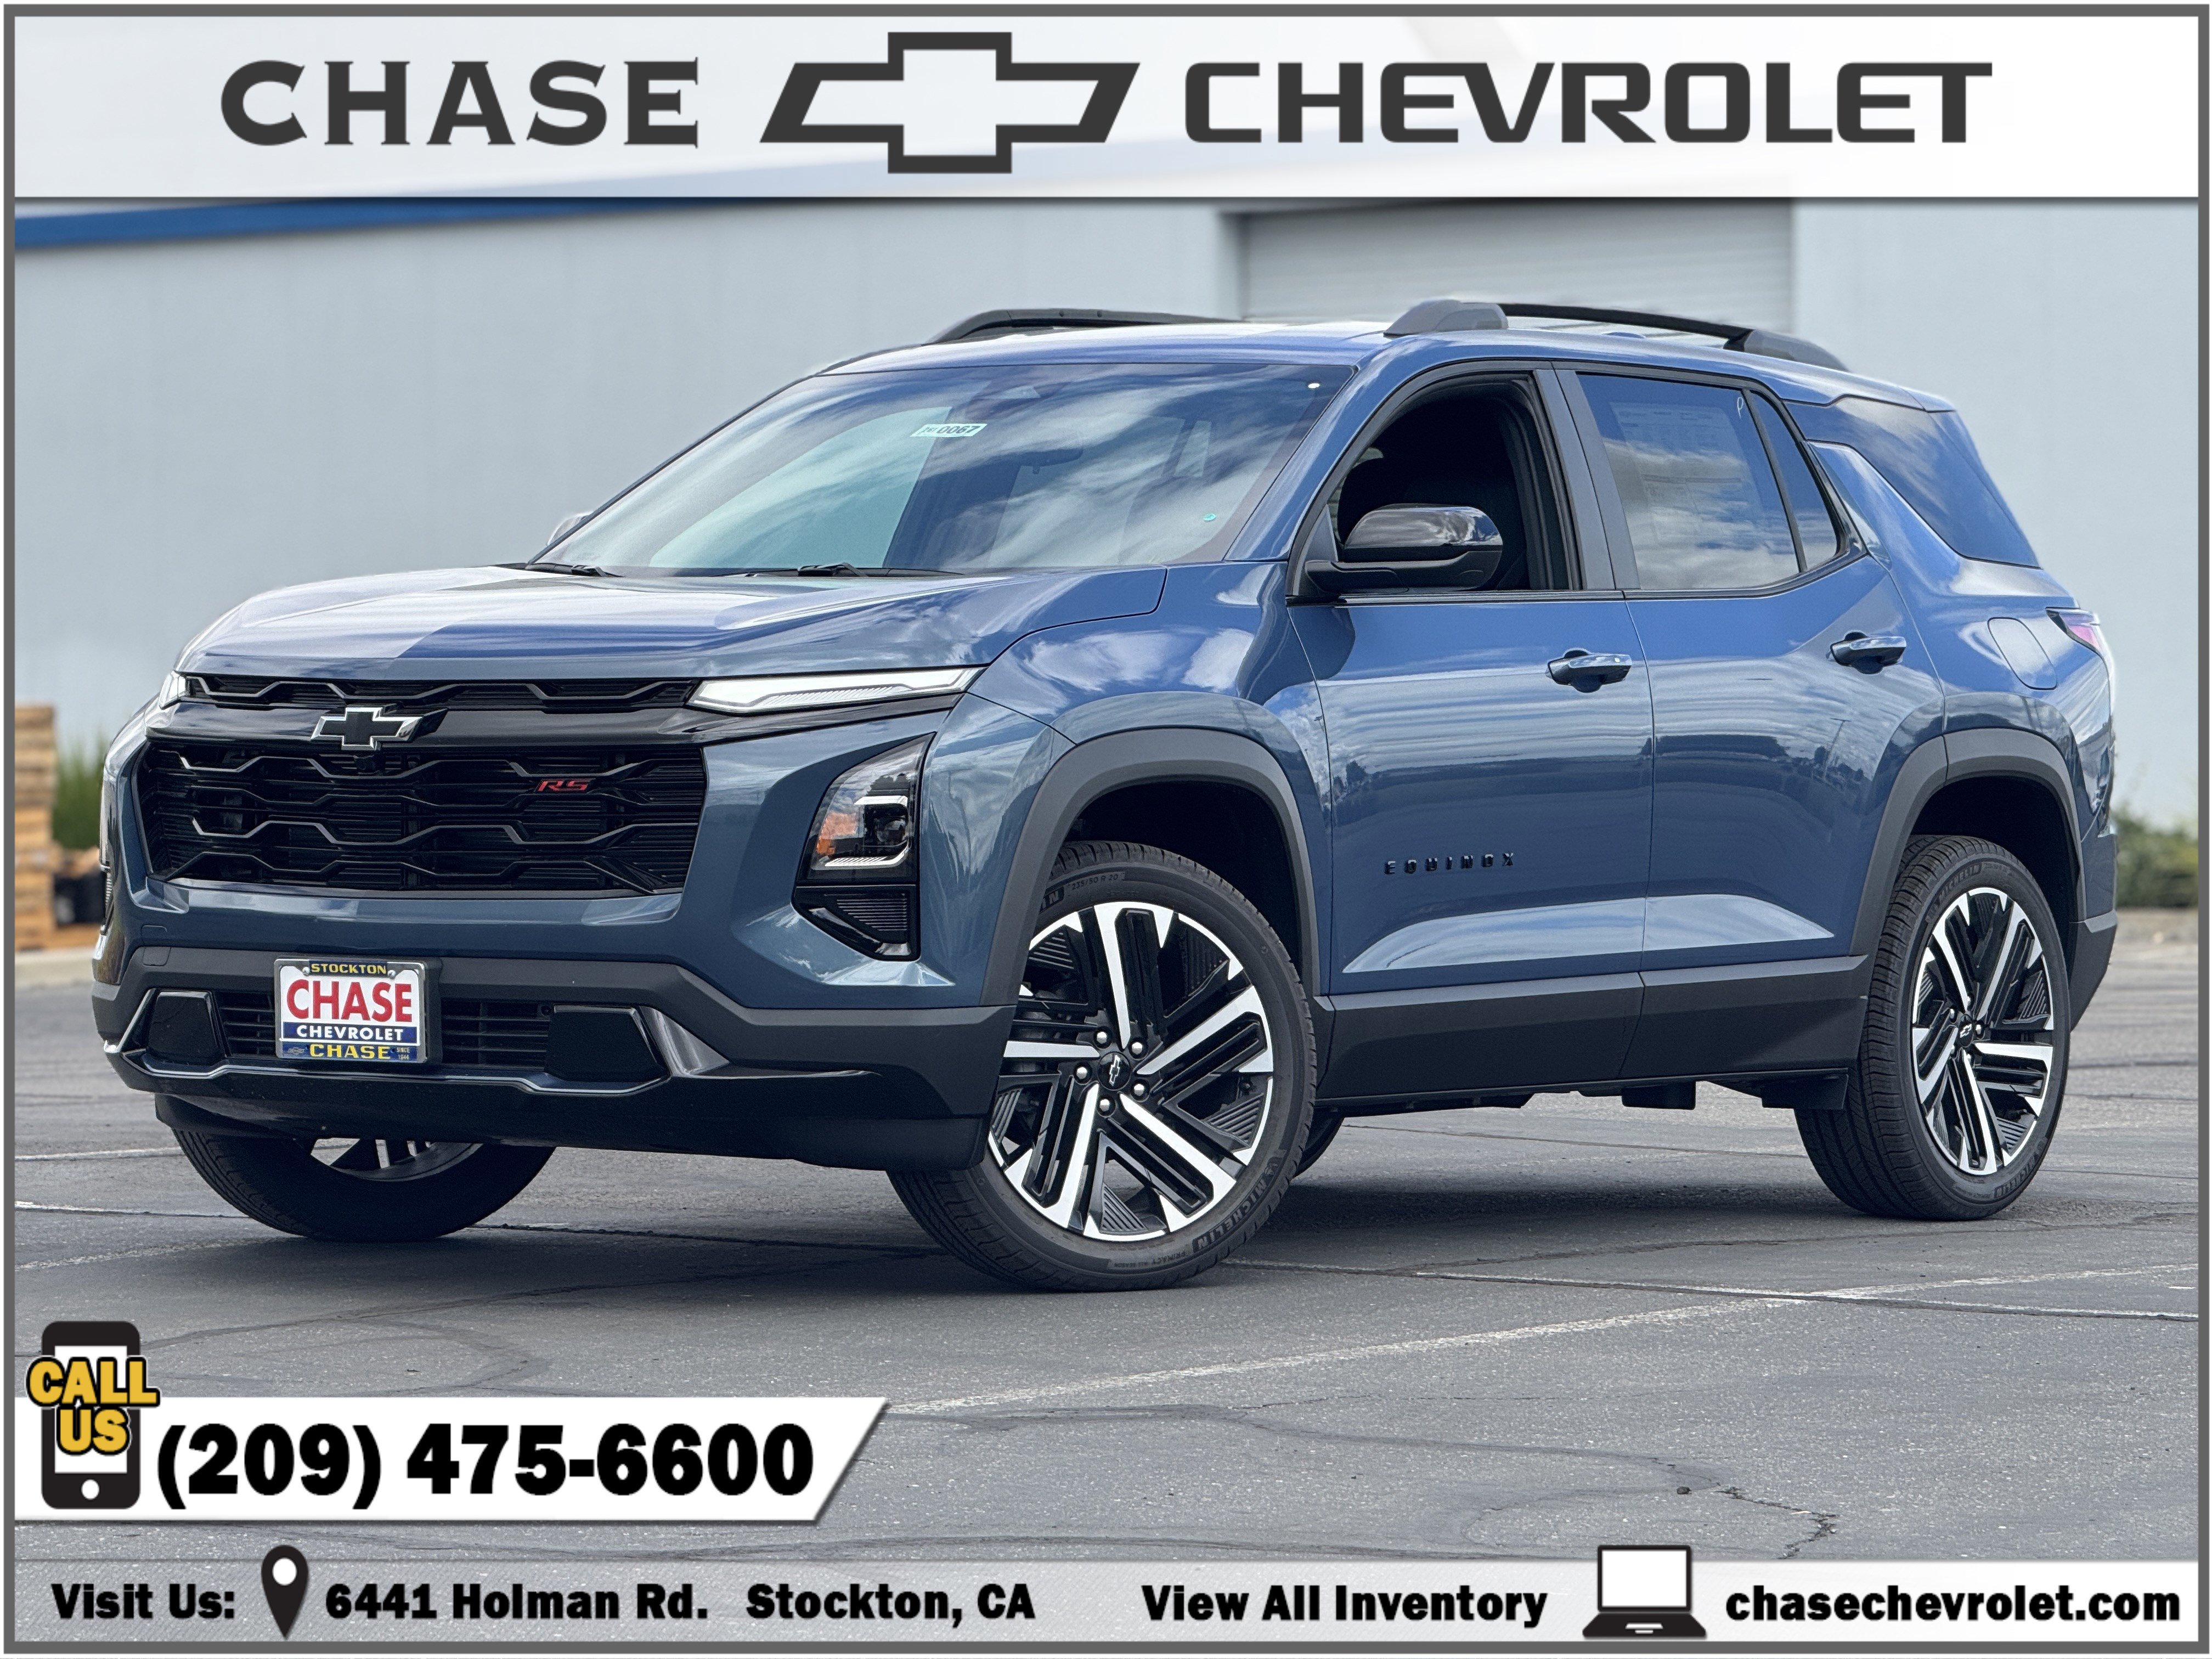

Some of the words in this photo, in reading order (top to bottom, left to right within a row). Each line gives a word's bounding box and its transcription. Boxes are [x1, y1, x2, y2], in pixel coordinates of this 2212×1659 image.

[537, 778, 592, 792] RS
[1384, 852, 1514, 874] EQUINOX
[311, 963, 387, 974] STOCKTON
[286, 979, 413, 1023] CHASE
[296, 1025, 404, 1041] CHEVROLET
[309, 1043, 391, 1060] CHASE
[1197, 1180, 1268, 1250] MICHELIN
